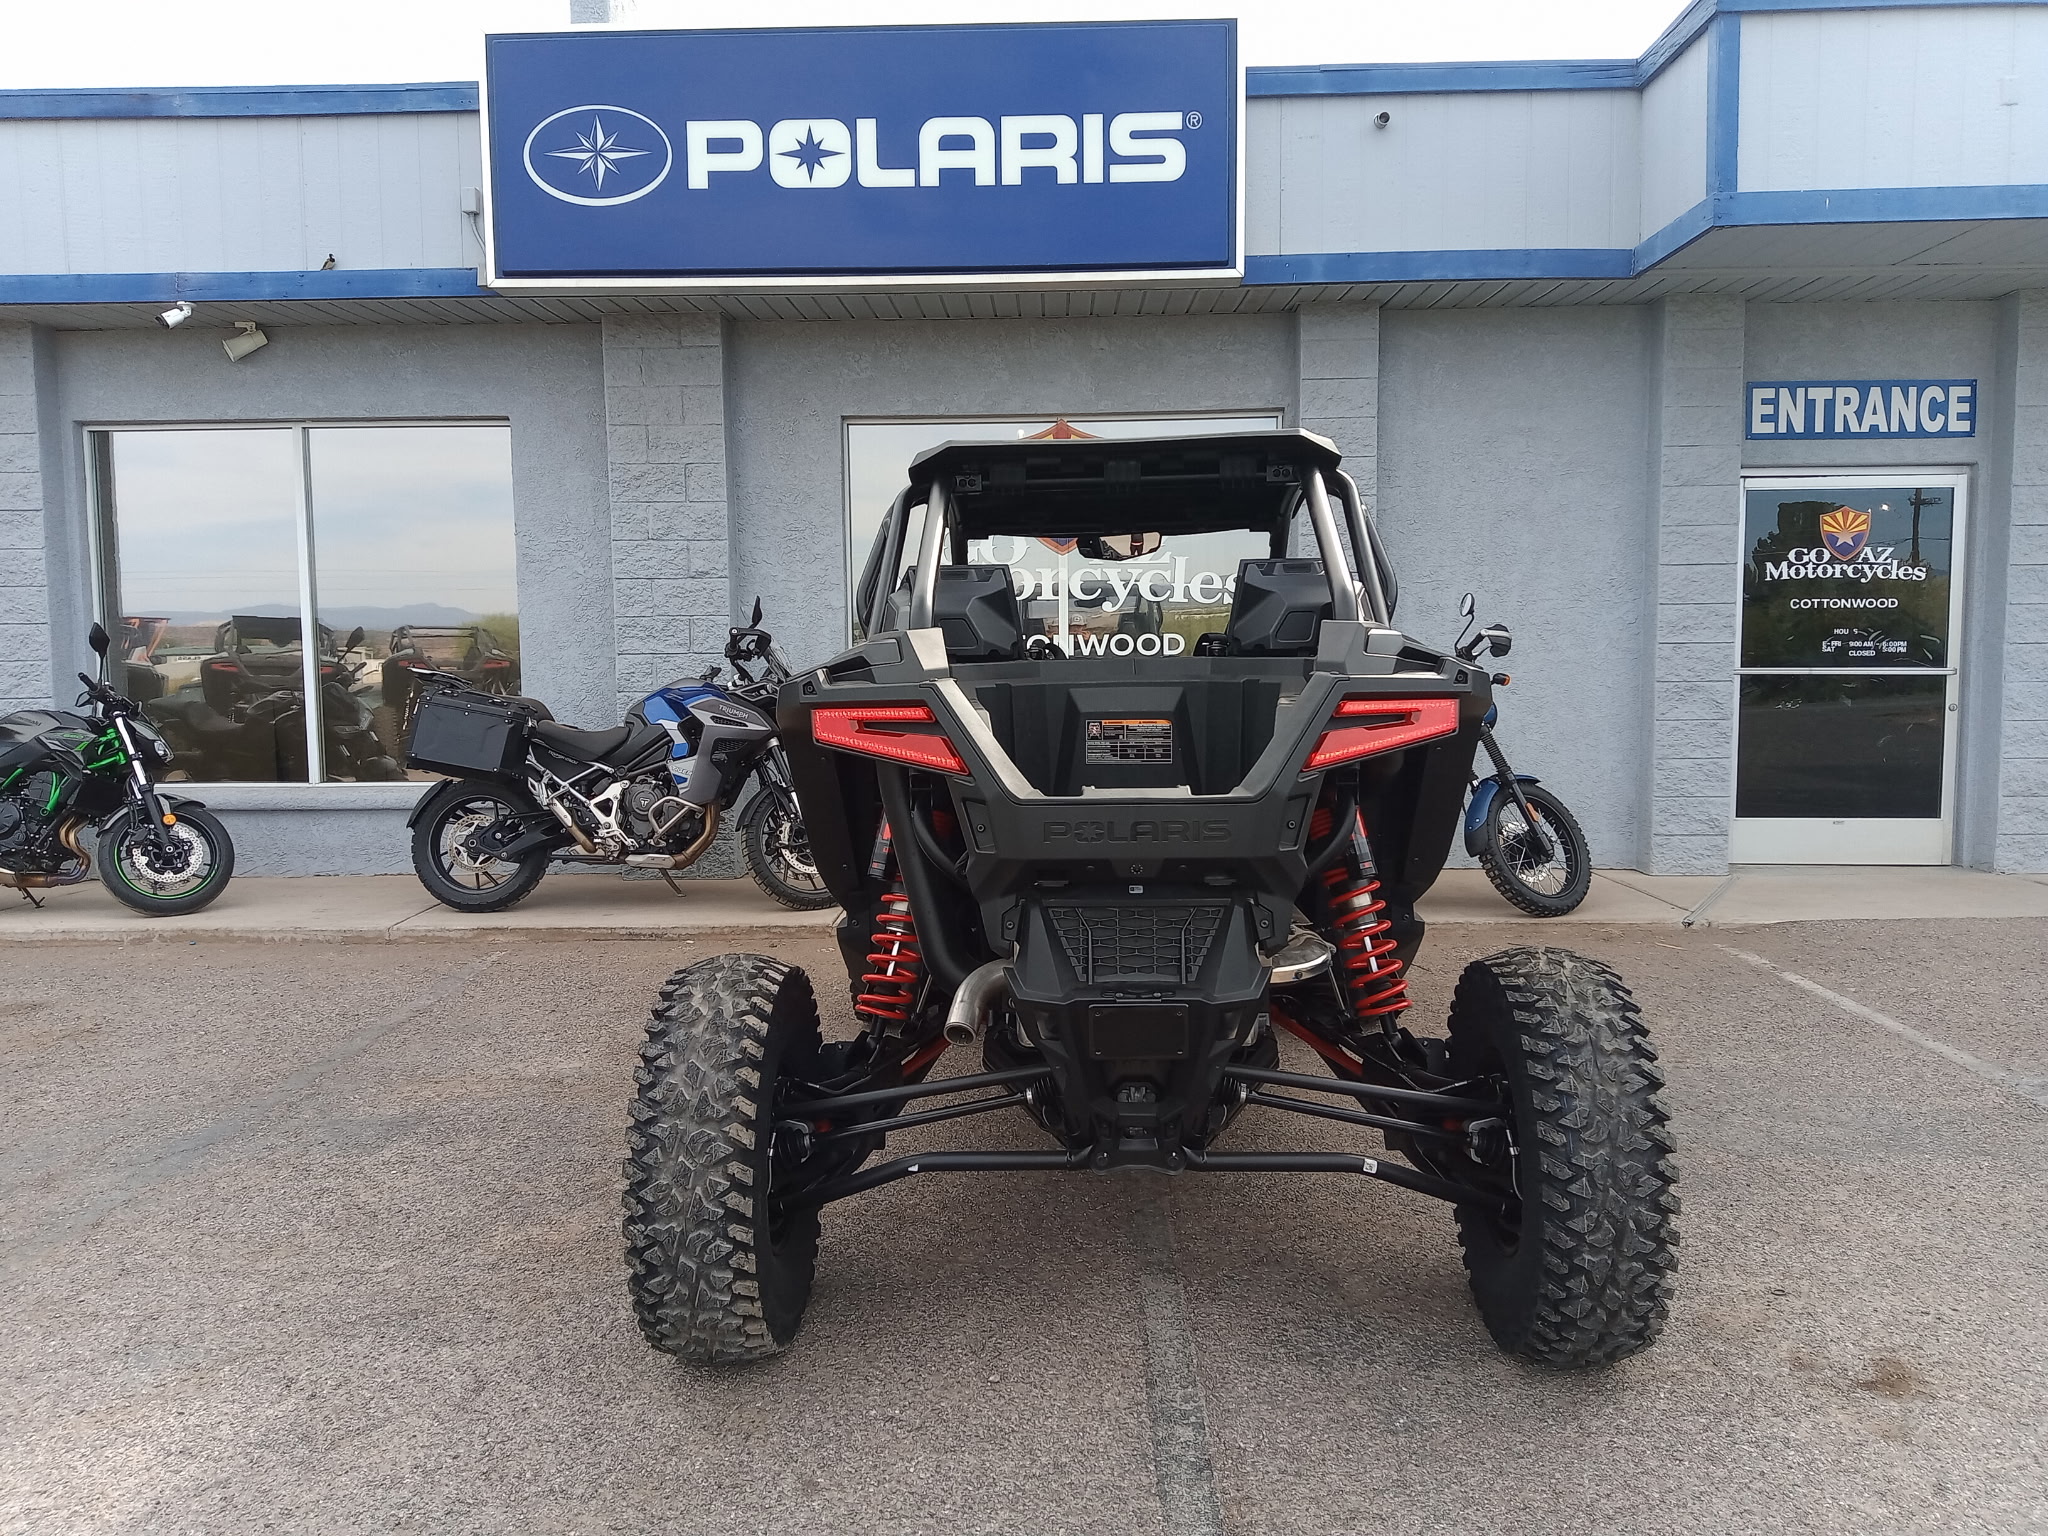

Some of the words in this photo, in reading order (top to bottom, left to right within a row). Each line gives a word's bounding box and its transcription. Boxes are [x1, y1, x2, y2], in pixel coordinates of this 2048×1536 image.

[1751, 385, 1972, 433] ENTRANCE
[1787, 547, 1831, 564] GO
[1856, 546, 1895, 563] AZ
[1764, 559, 1927, 583] Motorcycles
[1790, 598, 1899, 609] COTTONWOOD
[1848, 649, 1876, 657] CLOSED
[719, 703, 749, 719] TRIUMPH
[1043, 820, 1233, 844] POLARIS
